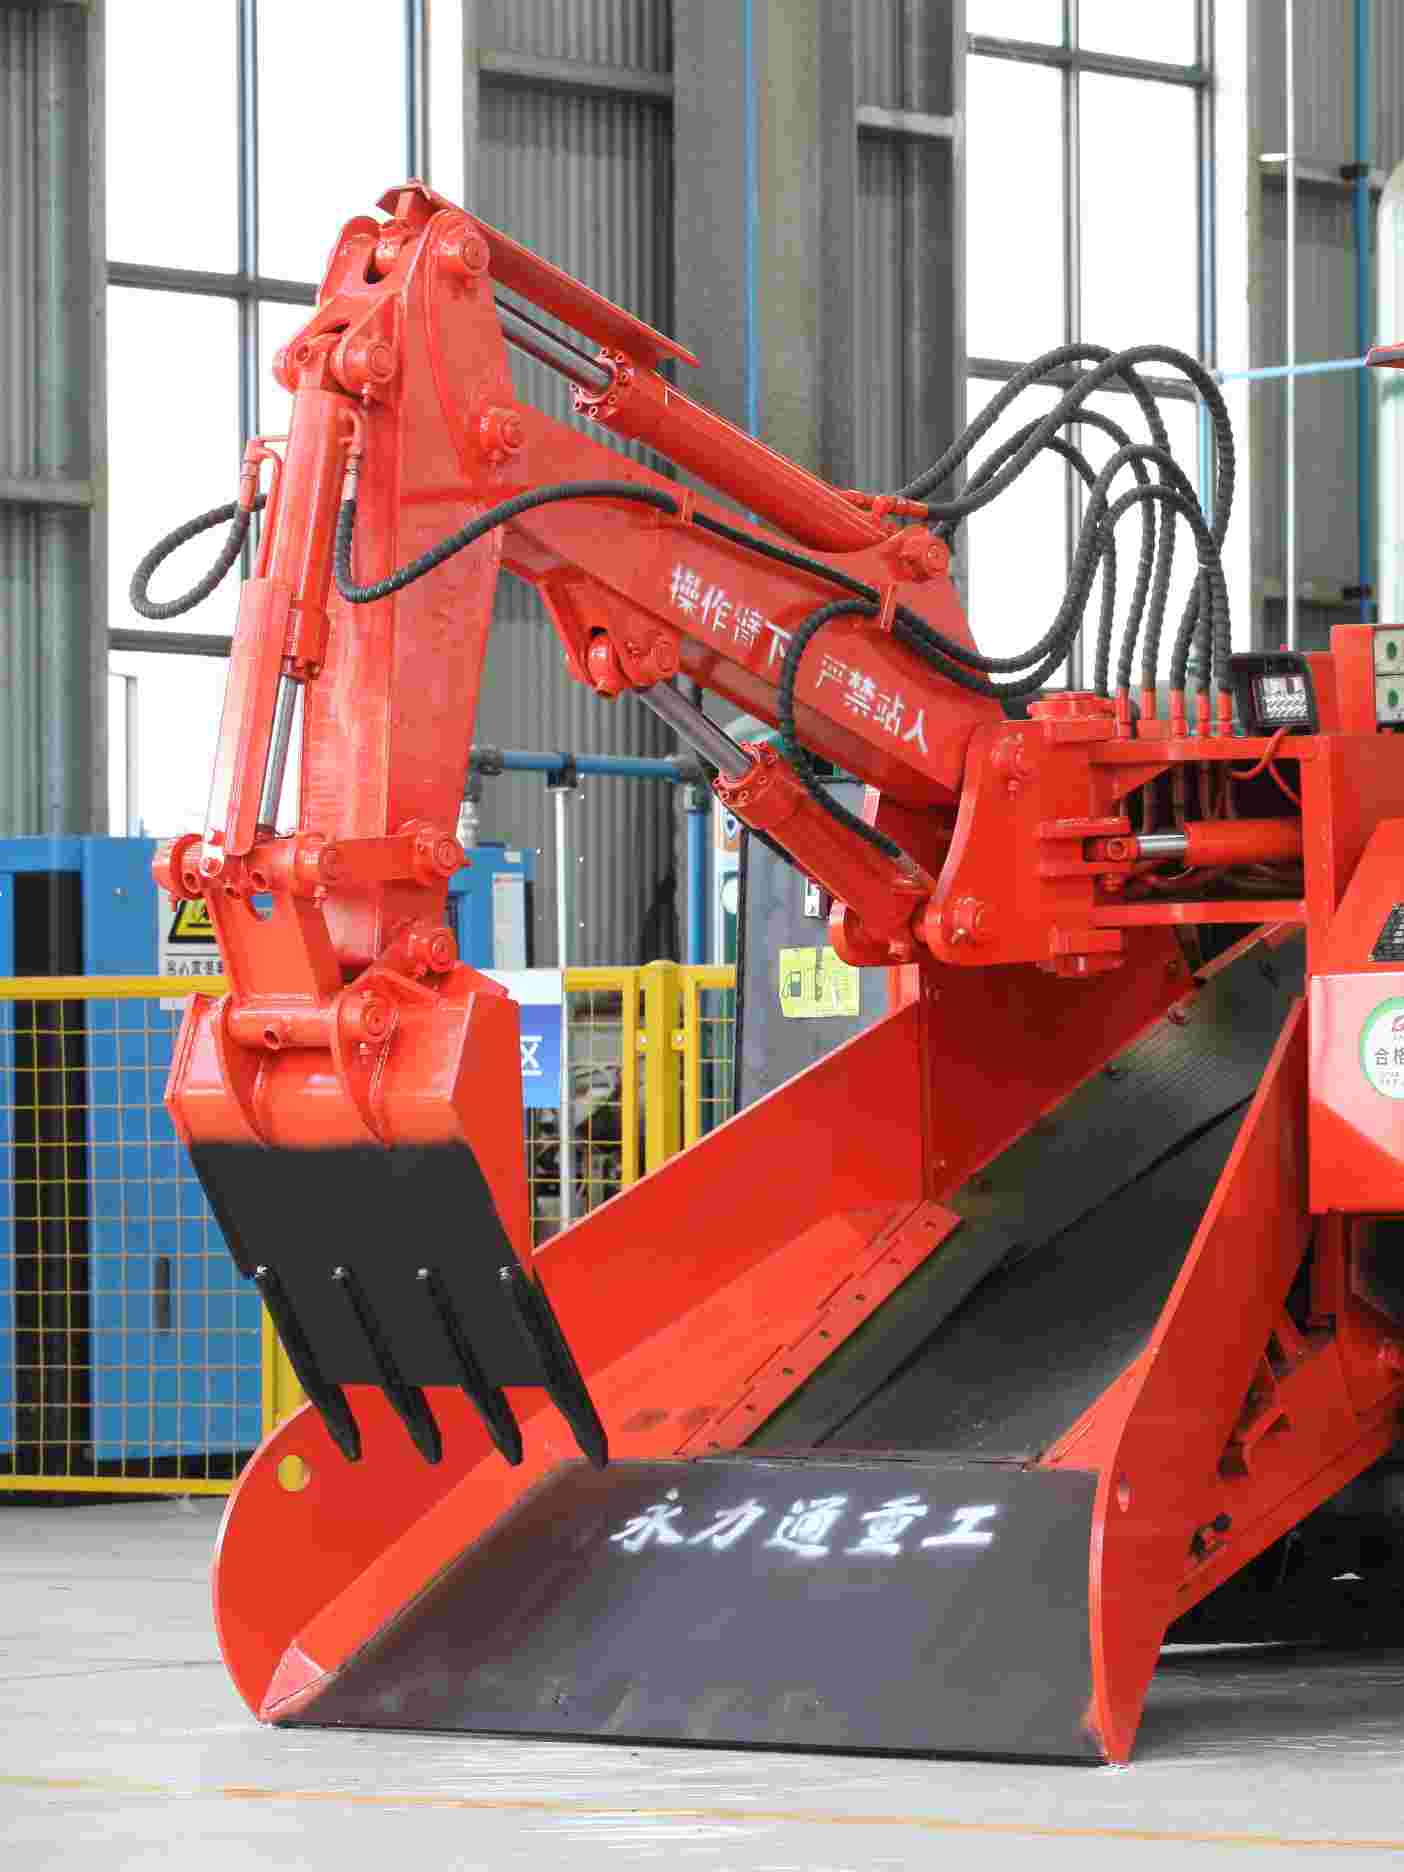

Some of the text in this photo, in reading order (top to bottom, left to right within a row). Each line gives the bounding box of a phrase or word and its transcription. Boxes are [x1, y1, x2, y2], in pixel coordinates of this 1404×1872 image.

[815, 655, 928, 753] 严禁站人
[608, 1487, 998, 1557] 永力通重工
